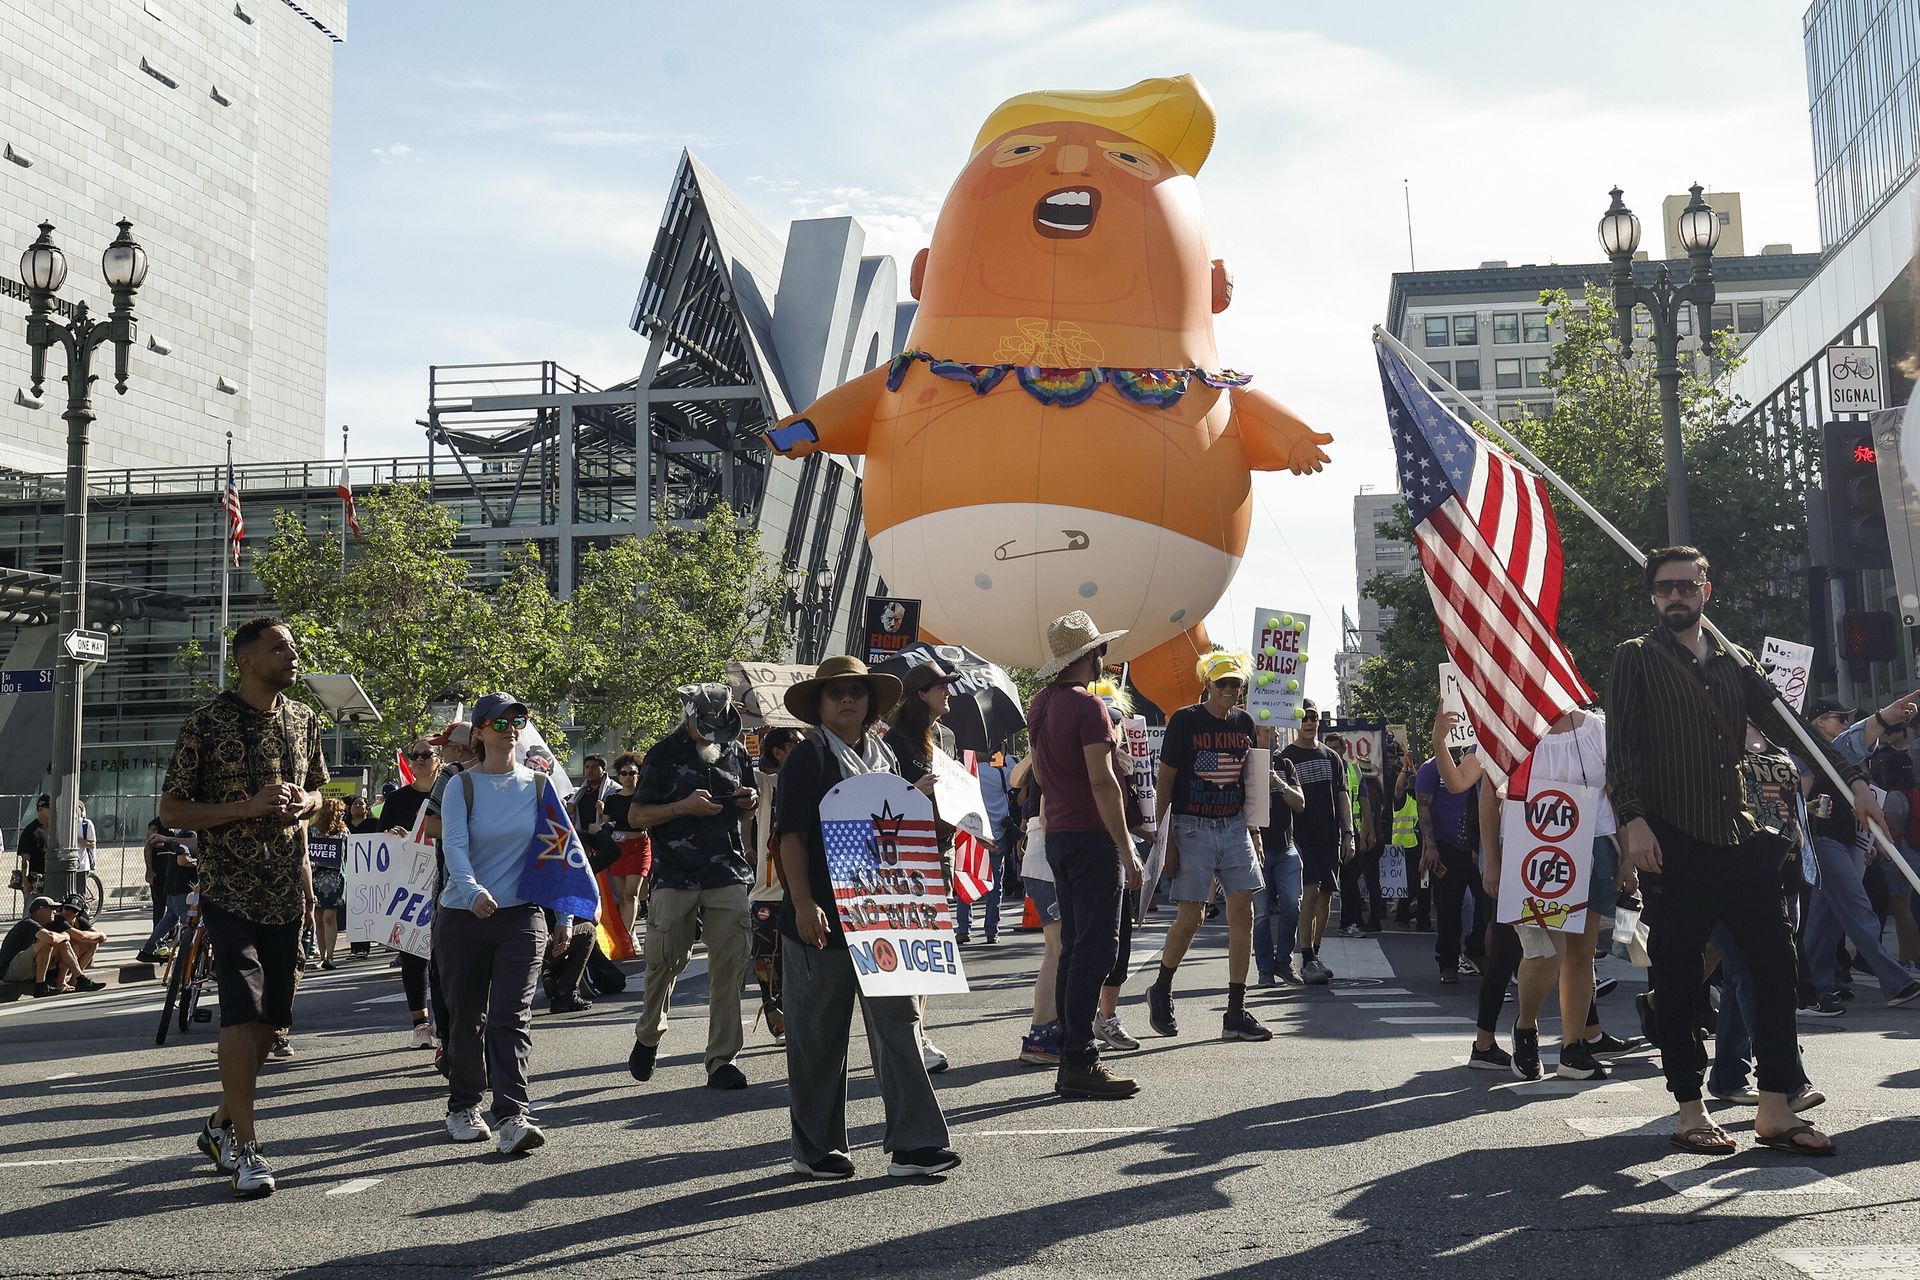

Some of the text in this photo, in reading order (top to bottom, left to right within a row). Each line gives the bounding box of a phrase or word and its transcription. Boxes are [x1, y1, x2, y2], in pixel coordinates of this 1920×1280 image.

[1834, 388, 1877, 403] SIGNAL
[77, 639, 104, 652] ONE WAY
[870, 633, 909, 649] FIGHT
[1261, 628, 1301, 654] FREE
[1768, 642, 1791, 657] No:
[901, 644, 965, 676] NO
[1256, 653, 1298, 675] BALLS!
[40, 671, 51, 682] St
[741, 667, 777, 685] NO
[946, 667, 997, 697] INGS
[1, 684, 14, 692] 100
[1193, 733, 1211, 749] NO
[1524, 801, 1577, 828] WAR
[308, 850, 337, 859] WER
[354, 840, 390, 874] NO
[866, 840, 898, 865] NO
[850, 867, 926, 897] KINGS
[1530, 859, 1571, 883] ICE
[847, 898, 939, 930] NO WAR
[899, 938, 957, 976] ICE!
